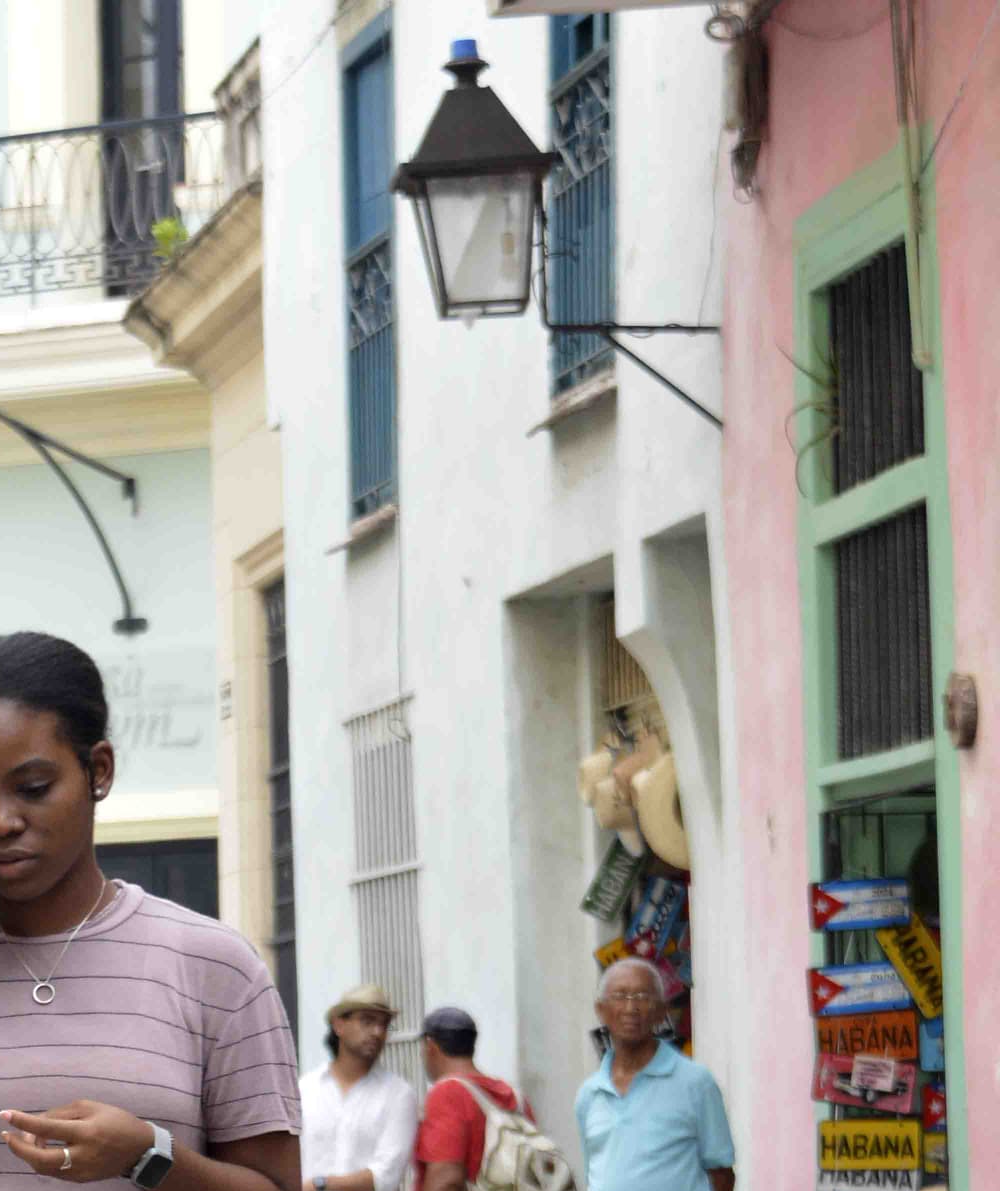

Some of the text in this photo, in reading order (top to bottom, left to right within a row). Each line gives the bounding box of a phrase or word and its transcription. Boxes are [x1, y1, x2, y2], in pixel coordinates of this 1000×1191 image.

[590, 853, 633, 920] HABAN
[818, 1024, 913, 1056] HABANA
[820, 1133, 915, 1161] HABANA
